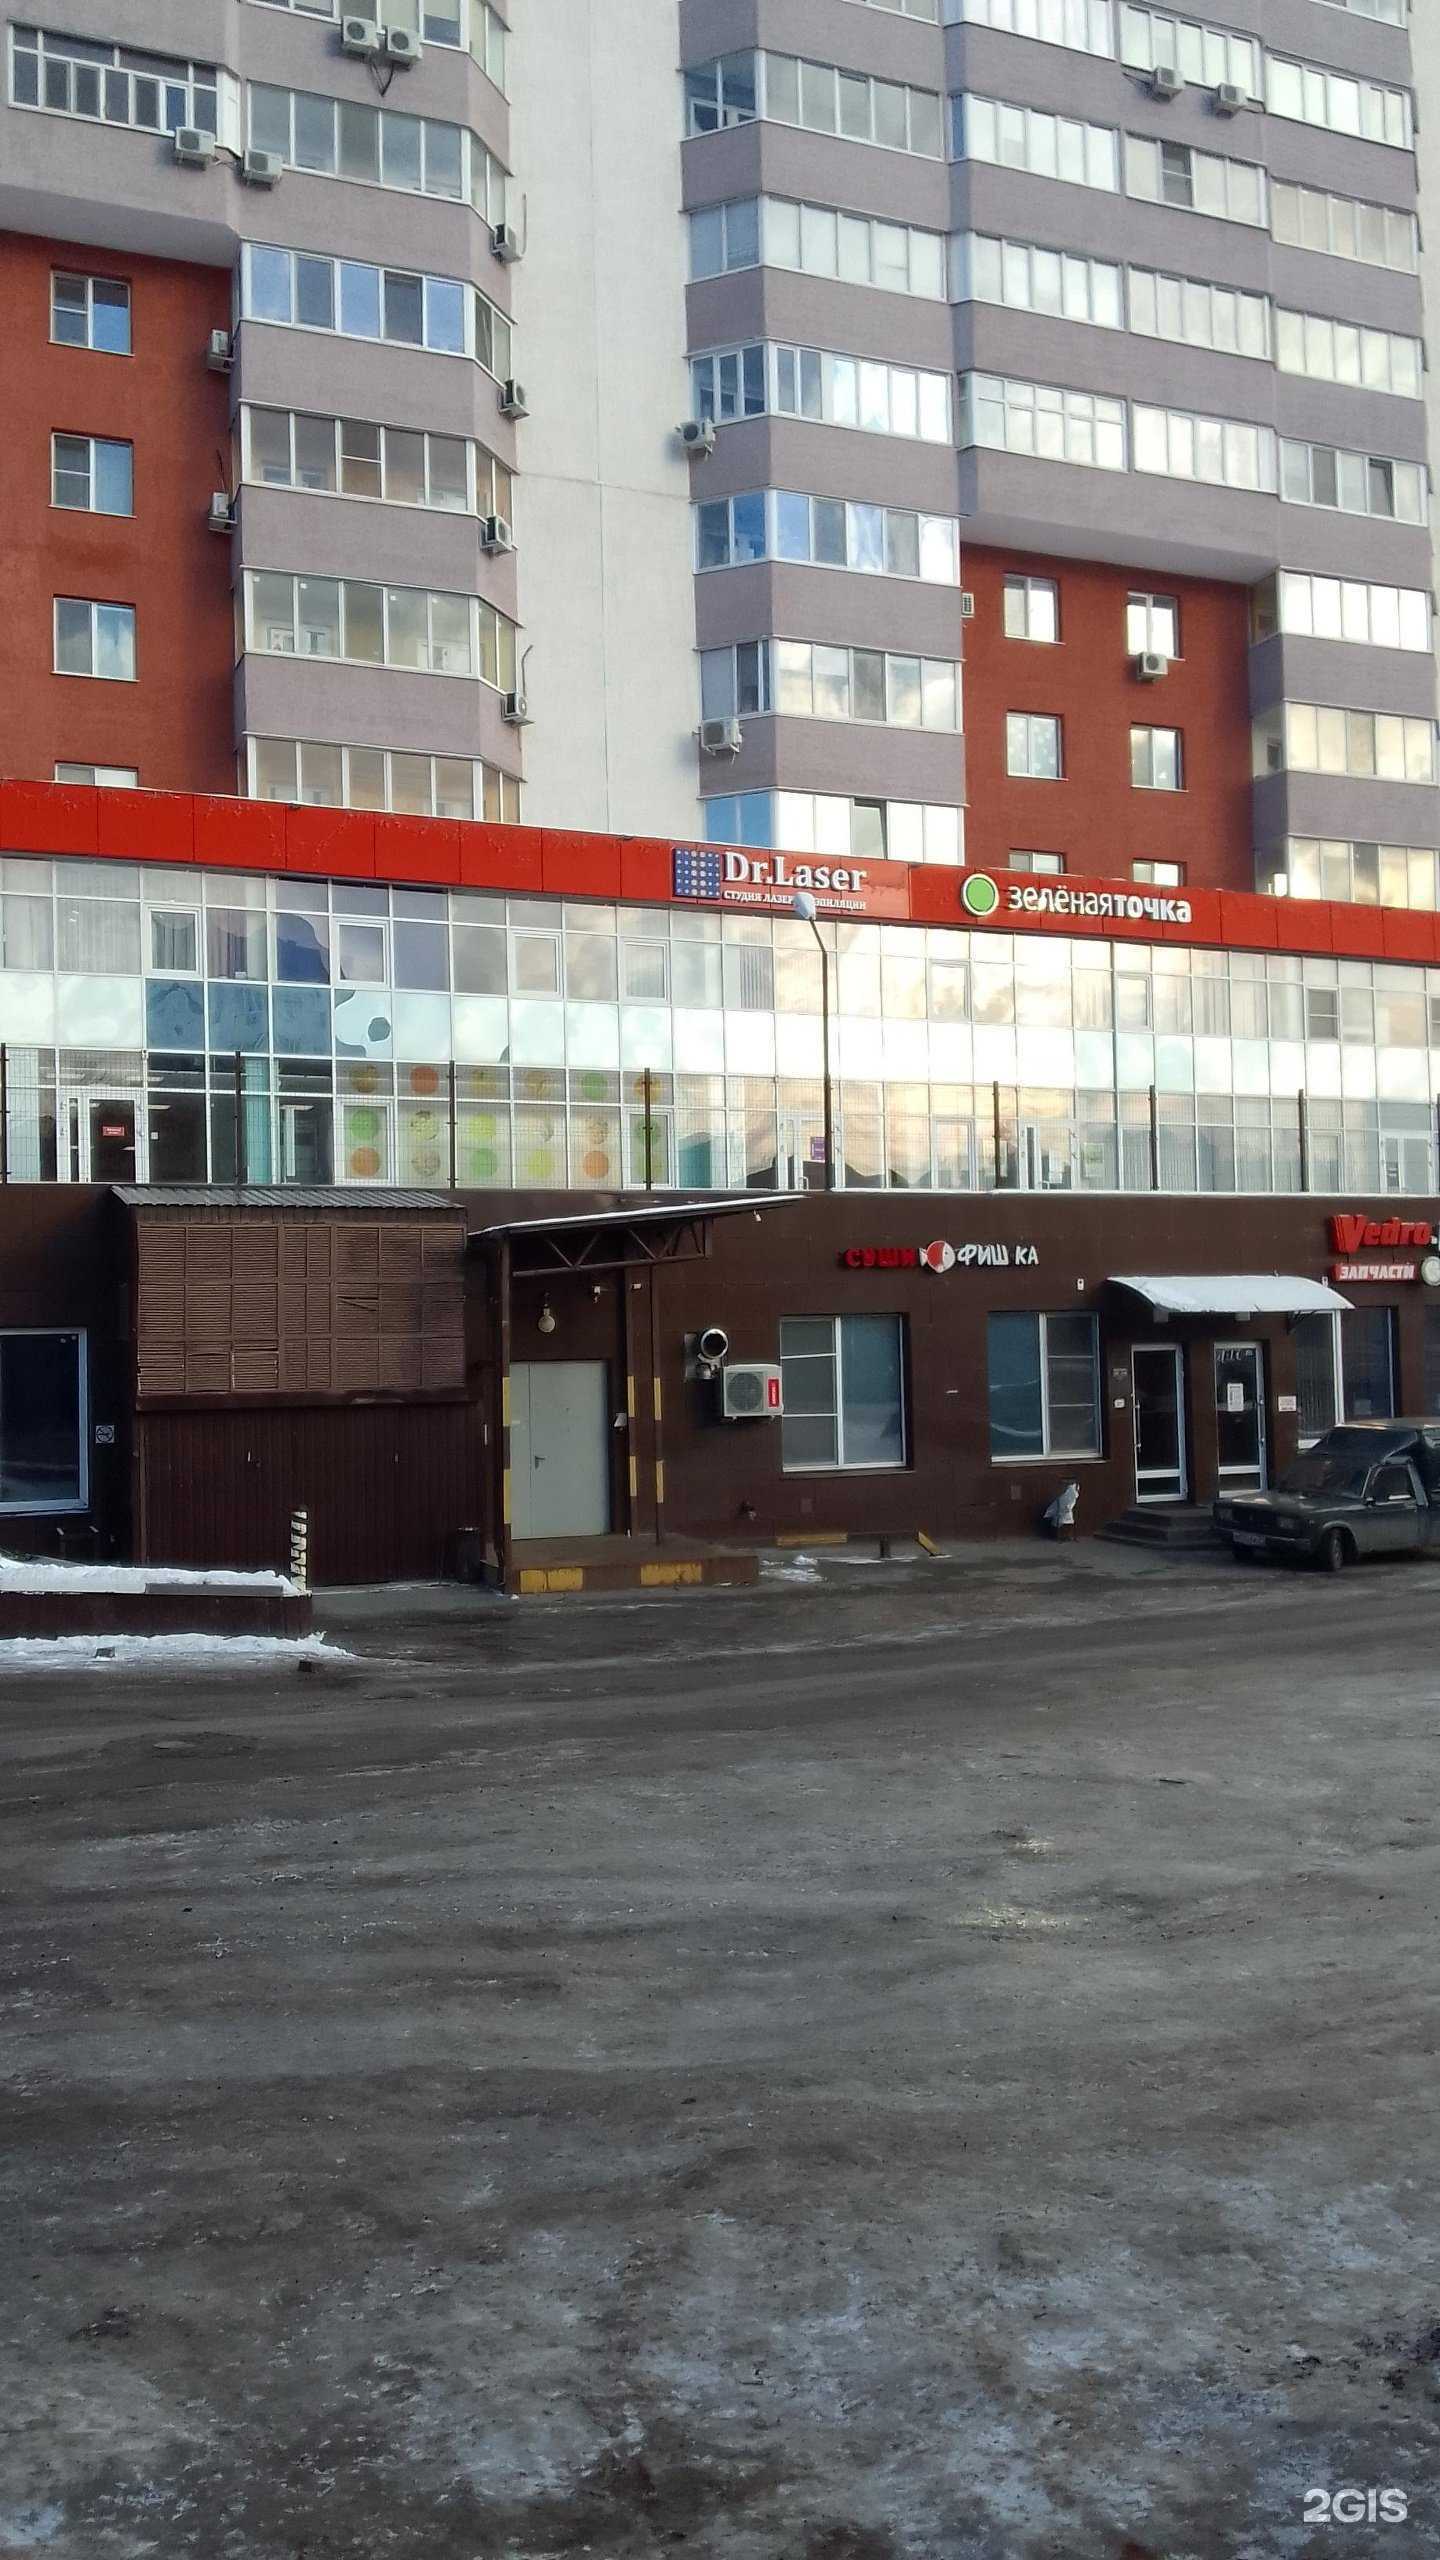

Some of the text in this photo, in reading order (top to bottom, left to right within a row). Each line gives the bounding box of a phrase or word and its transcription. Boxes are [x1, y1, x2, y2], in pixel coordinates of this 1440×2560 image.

[724, 851, 868, 891] Dr.Laser
[724, 890, 761, 903] СТУДИЯ
[1333, 1214, 1440, 1254] Vedro.
[1339, 1264, 1415, 1280] ЗАПЧАСТИ
